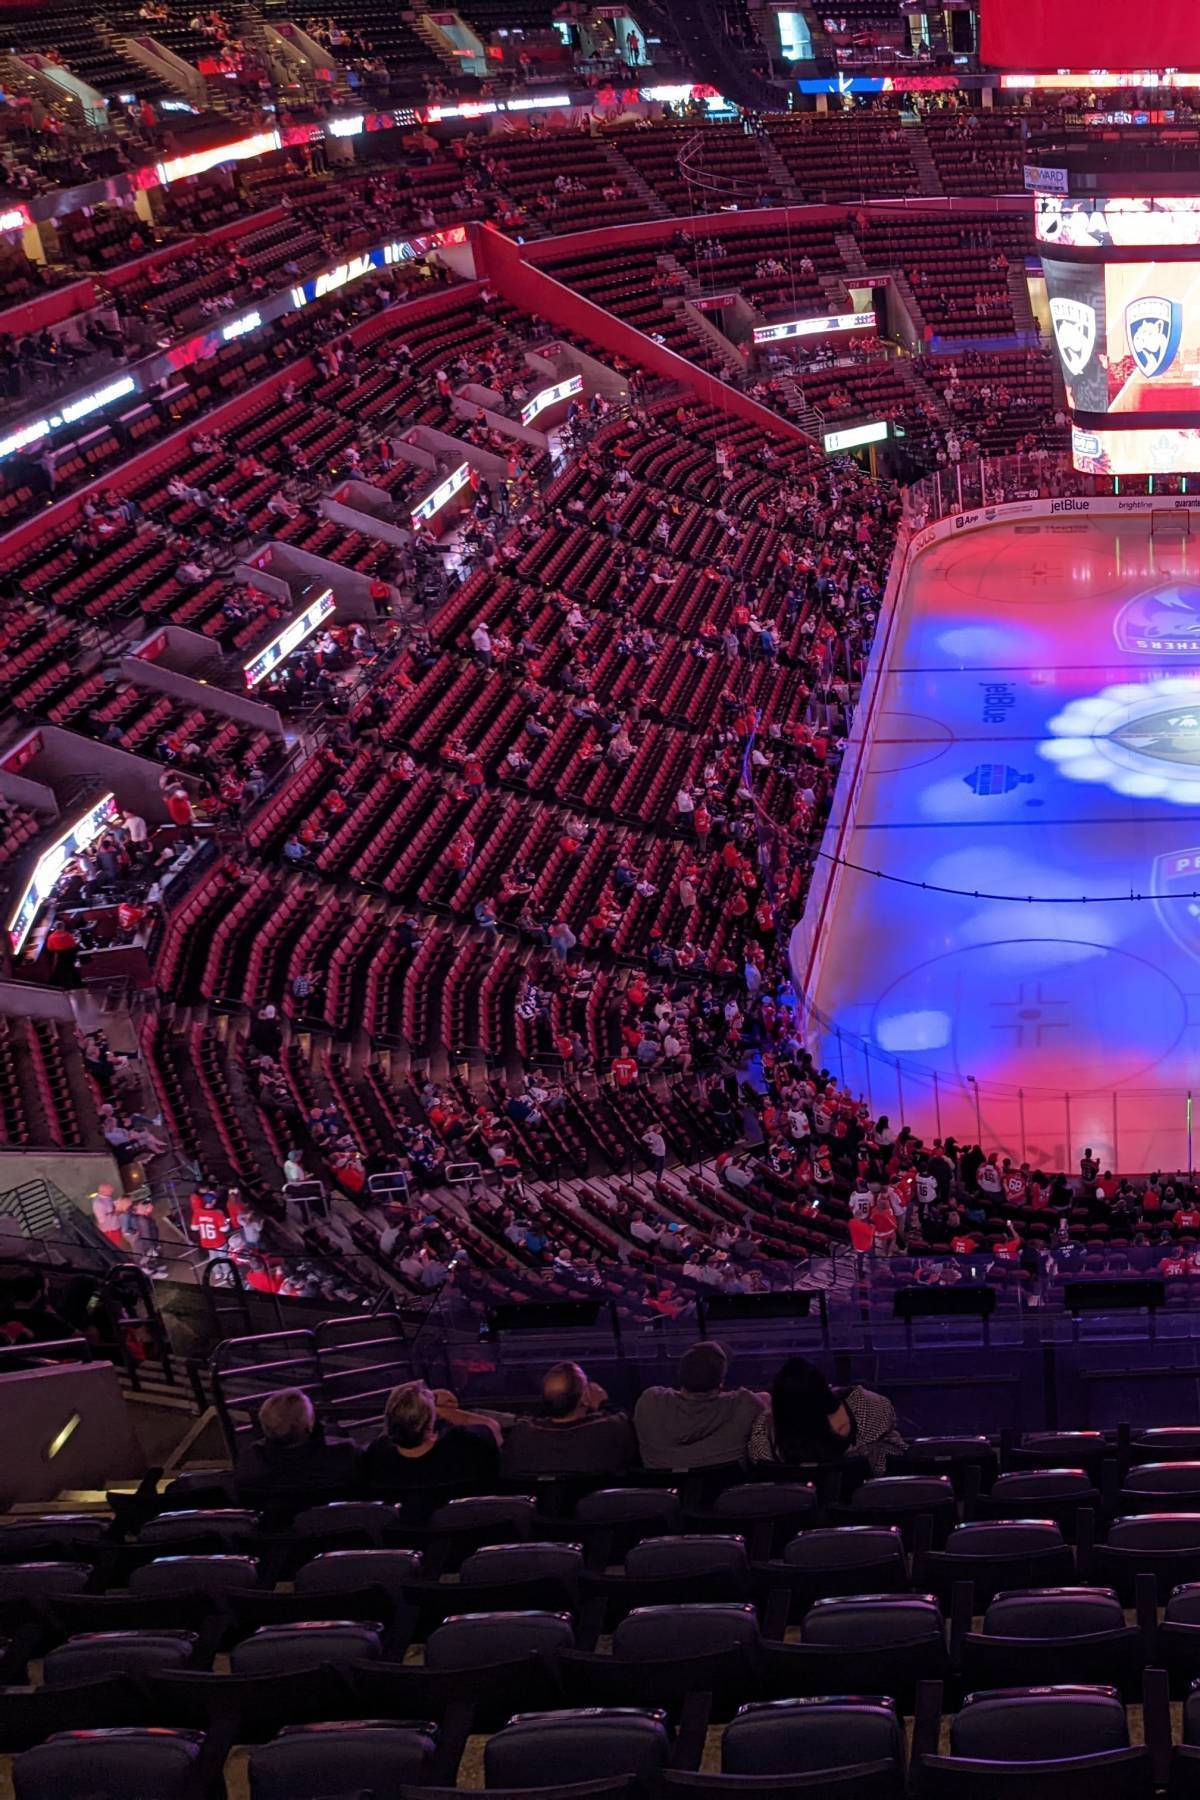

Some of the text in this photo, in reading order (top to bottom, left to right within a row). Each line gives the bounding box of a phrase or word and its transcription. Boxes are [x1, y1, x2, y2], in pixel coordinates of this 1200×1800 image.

[1050, 499, 1090, 513] jetBlue
[1118, 502, 1153, 511] brightline
[979, 682, 1017, 724] jetBlue
[200, 1223, 217, 1240] 16
